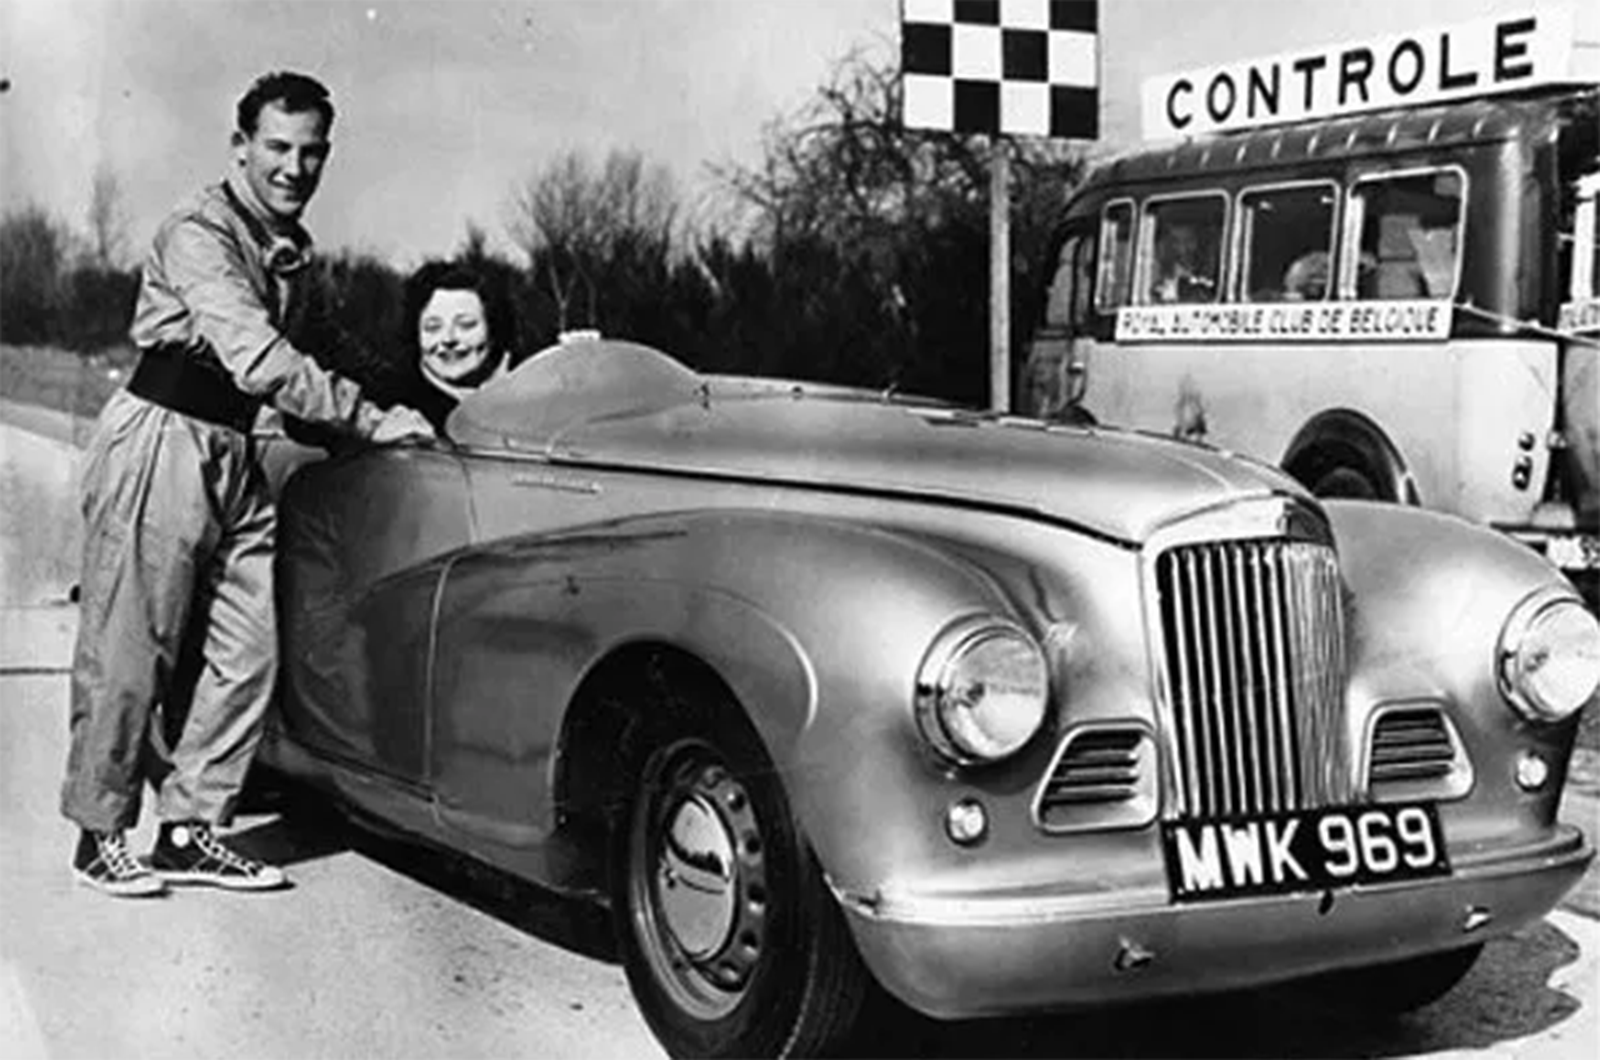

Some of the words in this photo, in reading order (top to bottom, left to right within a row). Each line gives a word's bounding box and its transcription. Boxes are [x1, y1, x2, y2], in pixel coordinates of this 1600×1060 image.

[1166, 17, 1537, 129] CONTROLE
[1269, 308, 1313, 333] CLUB
[1318, 308, 1343, 333] DE
[1349, 306, 1439, 333] BELGIQUE
[1175, 819, 1308, 891] MWK
[1318, 808, 1435, 876] 969
